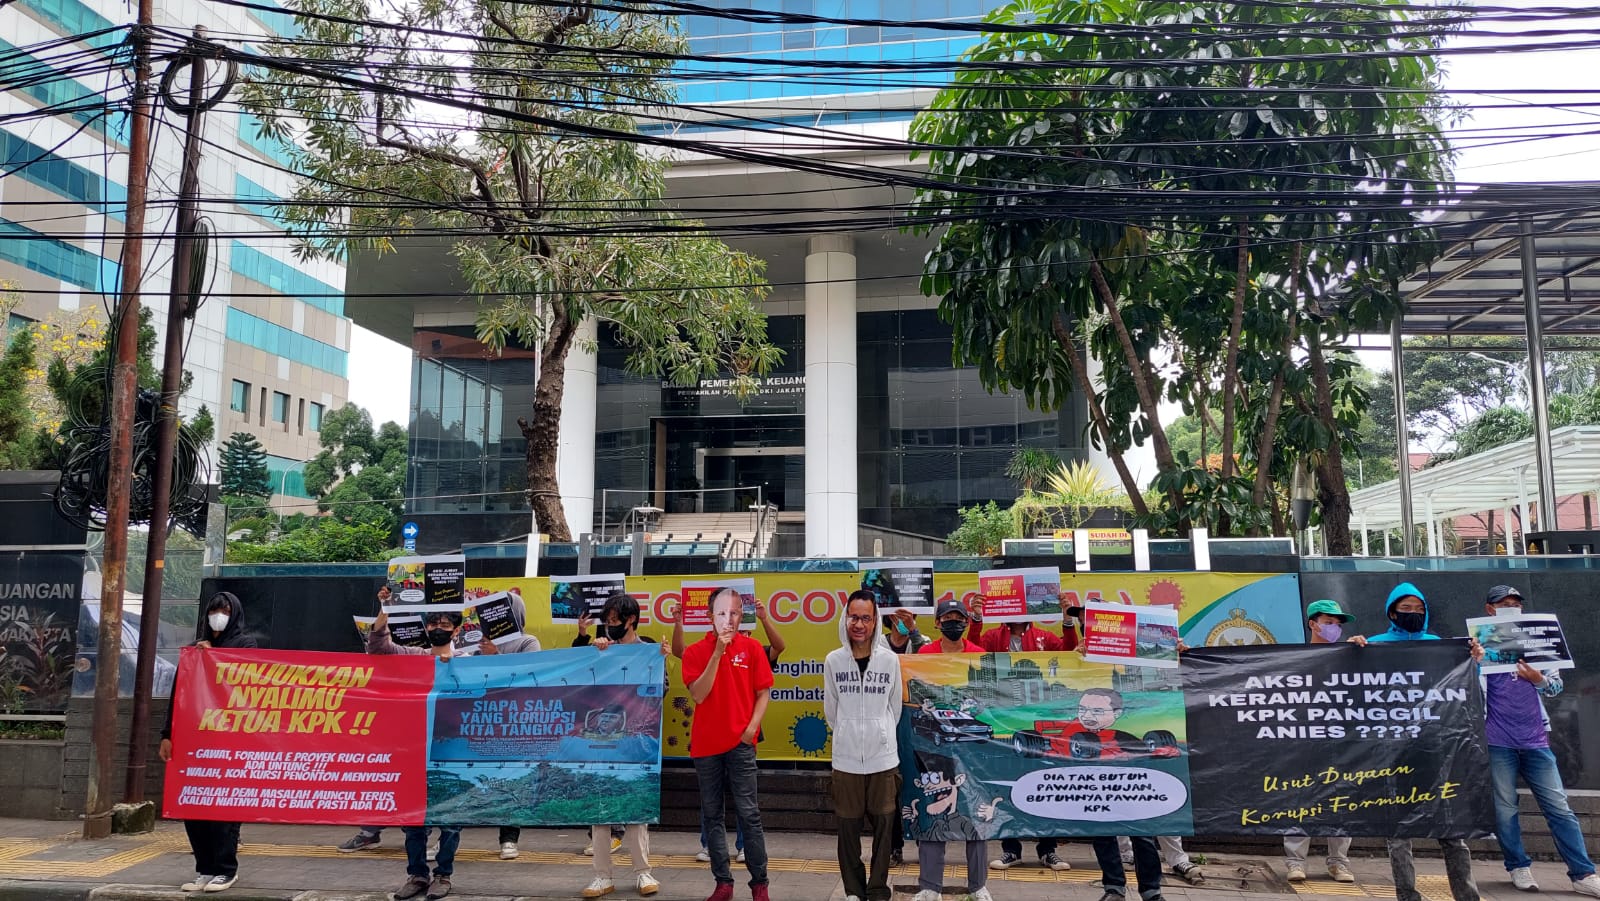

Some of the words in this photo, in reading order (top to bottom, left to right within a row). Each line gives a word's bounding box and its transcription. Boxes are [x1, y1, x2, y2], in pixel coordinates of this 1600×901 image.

[215, 663, 374, 688] TUNJUKKAN
[1245, 674, 1313, 689] AKSI
[1322, 671, 1425, 687] JUMAT
[228, 686, 347, 710] NYALIMU
[1208, 690, 1354, 707] KERAMAT,
[1364, 688, 1467, 703] KAPAN
[473, 700, 518, 712] SIAPA
[524, 699, 564, 712] SAJA
[461, 711, 504, 724] YANG
[508, 711, 576, 724] KORUPSI
[1237, 708, 1298, 722] KPK
[1307, 707, 1441, 721] PANGGIL
[199, 709, 282, 734] KETUA
[287, 711, 347, 734] KPK
[349, 712, 377, 735] !!
[460, 723, 495, 736] KITA
[500, 723, 575, 736] TANGKAP
[1256, 725, 1346, 739] ANIES
[1355, 725, 1422, 739] ????
[195, 749, 232, 760] GAWAT,
[235, 751, 282, 761] FORMULA
[285, 752, 293, 761] E
[294, 753, 336, 763] PROYEK
[337, 754, 365, 763] RUGI
[367, 754, 392, 763] GAK
[244, 761, 265, 770] ADA
[268, 762, 310, 771] UNTUNG
[311, 763, 327, 772] !!!
[186, 767, 222, 779] WALAH,
[225, 769, 247, 778] KOK
[250, 770, 281, 780] KURSI
[282, 771, 340, 781] PENONTON
[341, 772, 401, 783] MENYUSUT
[1098, 772, 1148, 781] BUTUH
[1263, 775, 1316, 793] Usut
[1318, 764, 1416, 786] Dugaan
[182, 786, 229, 797] MASALAH
[231, 787, 259, 797] DEMI
[260, 788, 311, 799] MASALAH
[312, 791, 357, 800] MUNCUL
[360, 791, 395, 800] TERUS
[1036, 783, 1098, 792] PAWANG
[215, 797, 260, 807] NIATNYA
[288, 799, 314, 809] BAIK
[316, 800, 349, 810] PASTI
[350, 801, 373, 810] ADA
[1026, 794, 1103, 802] BUTUHNYA
[1241, 803, 1323, 826] Korupsi
[1328, 785, 1436, 814] Formula
[1438, 782, 1462, 800] E
[1083, 804, 1111, 812] KPK
